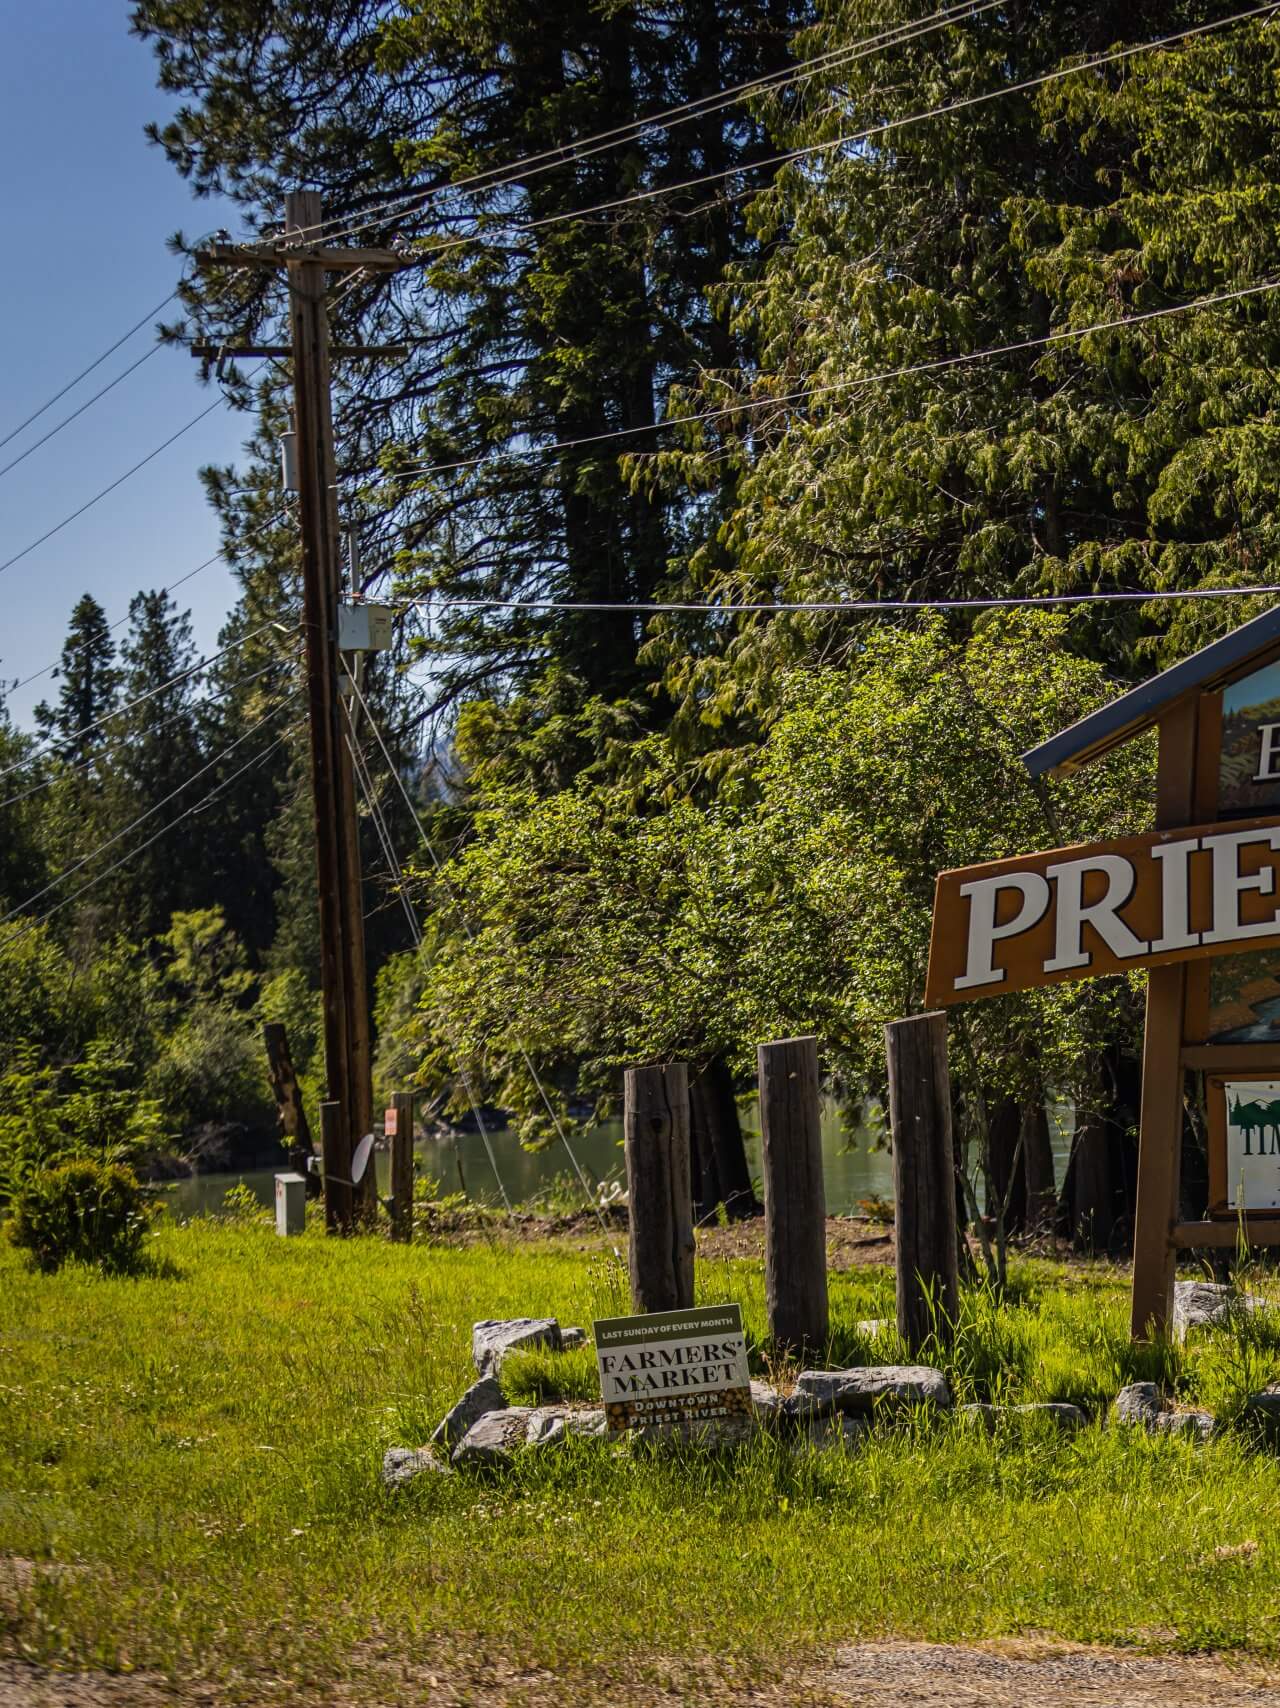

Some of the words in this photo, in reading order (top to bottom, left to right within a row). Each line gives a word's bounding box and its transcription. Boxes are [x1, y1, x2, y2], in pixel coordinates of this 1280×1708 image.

[602, 1331, 622, 1340] LAST
[623, 1326, 659, 1337] SUNDAY
[660, 1324, 672, 1333] OF
[673, 1321, 700, 1332] EVERY
[701, 1317, 734, 1328] MONTH
[614, 1363, 737, 1394] MARKET
